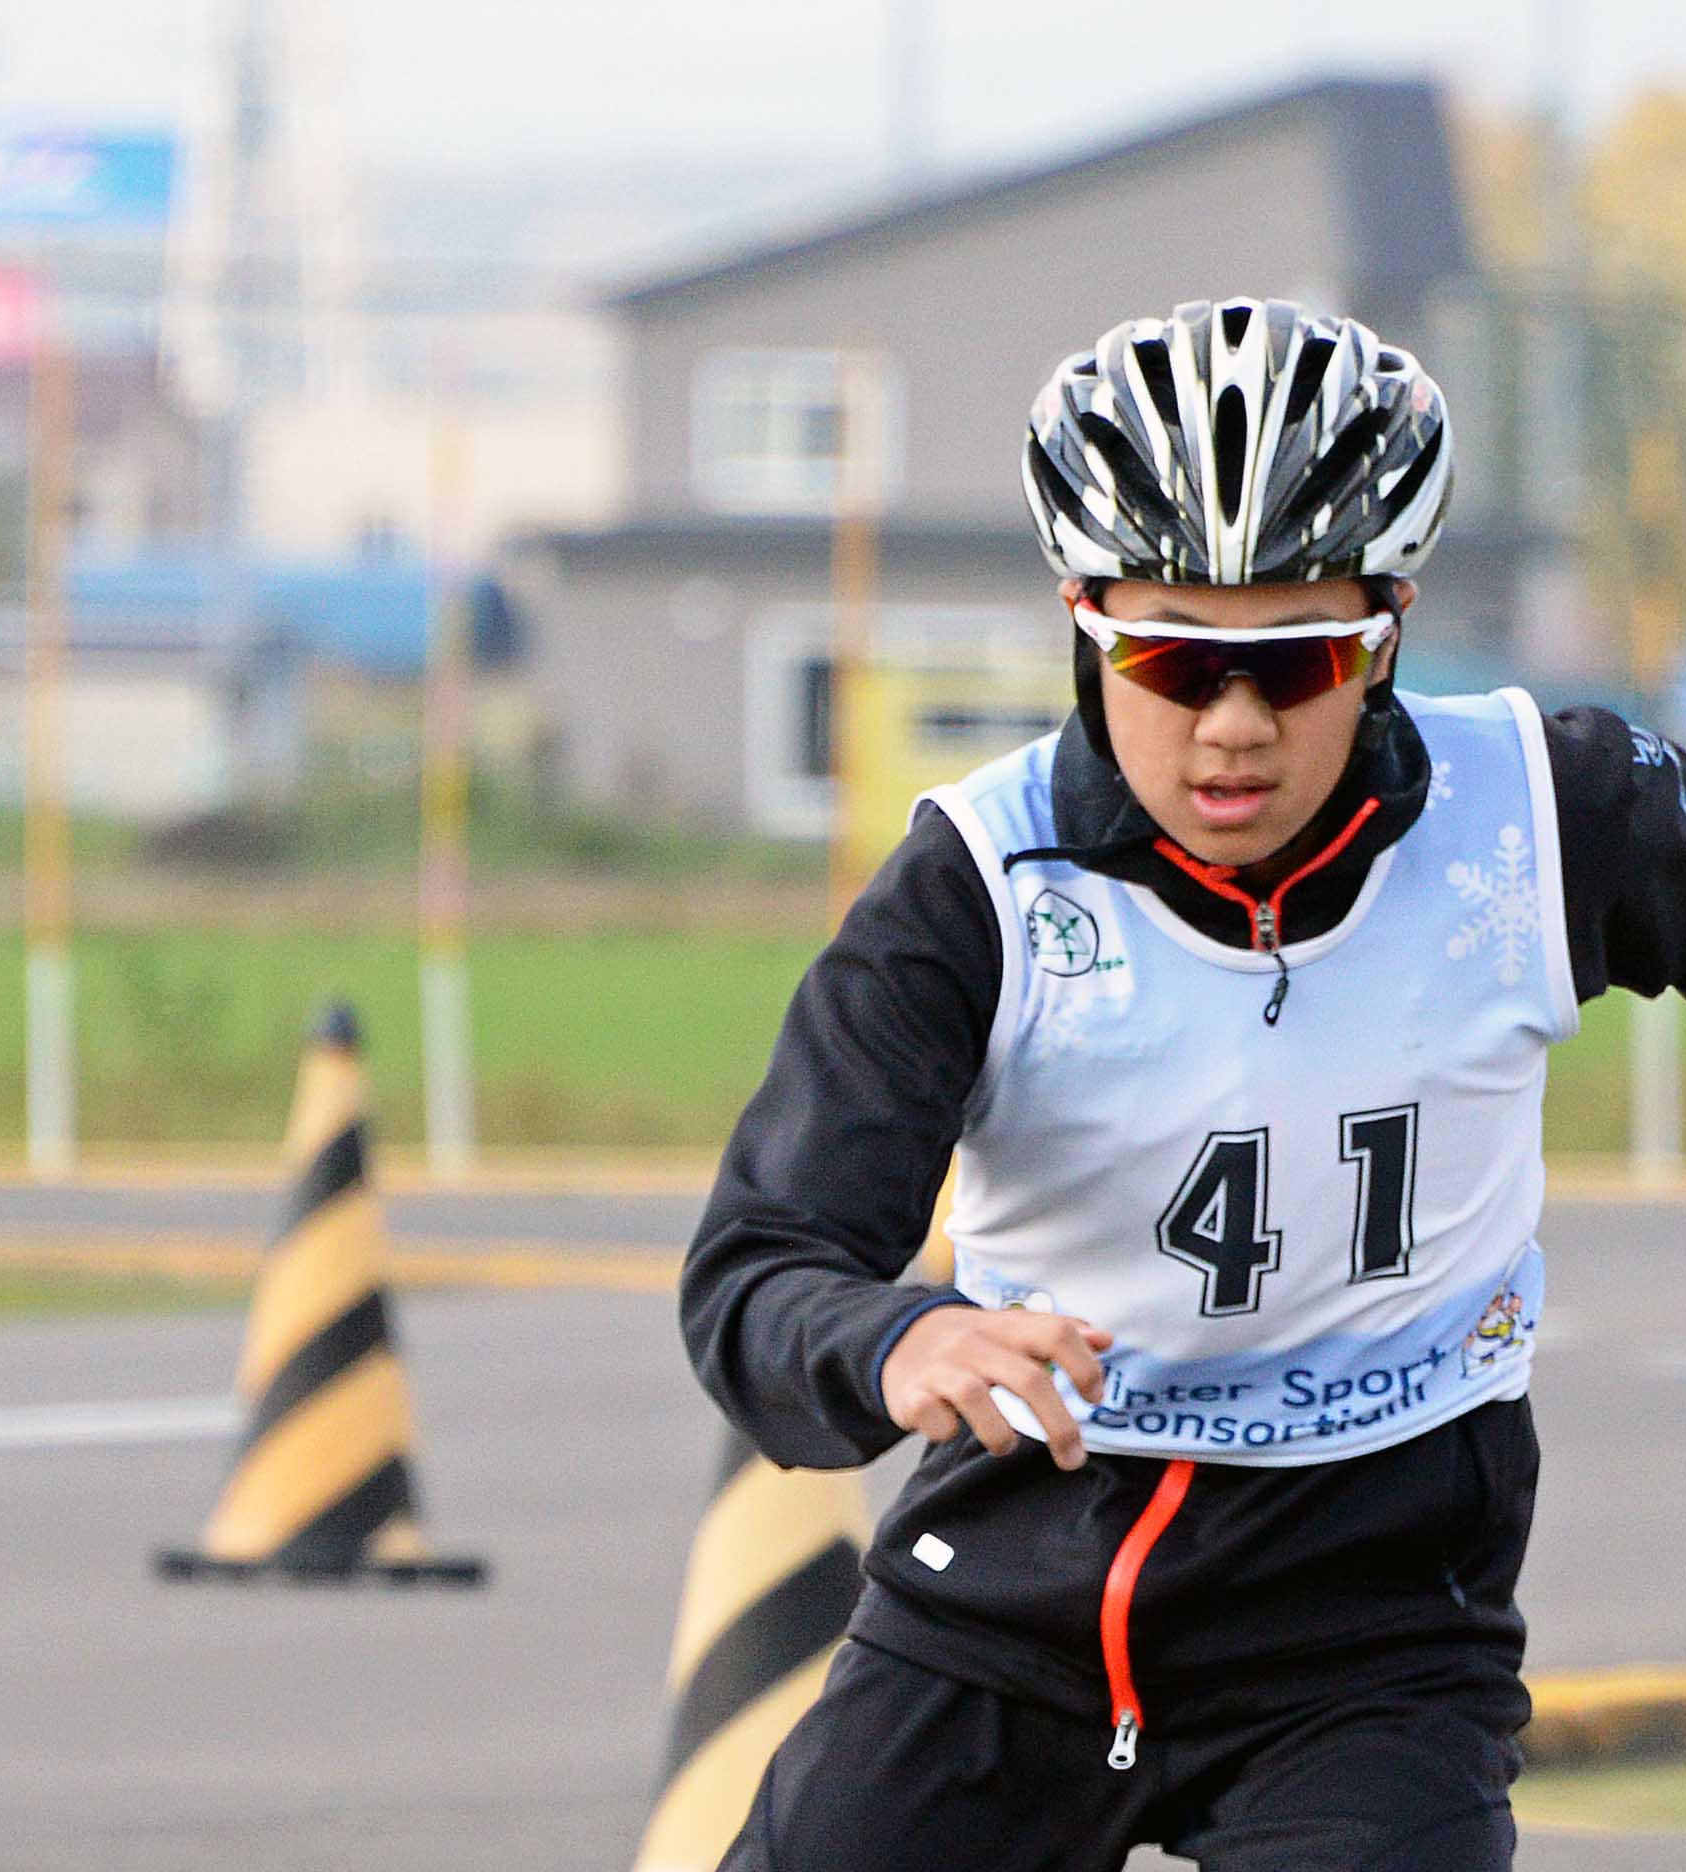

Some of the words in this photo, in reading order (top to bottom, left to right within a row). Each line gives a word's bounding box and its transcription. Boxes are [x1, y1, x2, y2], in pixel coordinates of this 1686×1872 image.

[1156, 1103, 1420, 1318] 41
[1090, 1383, 1427, 1449] Consortium
[1102, 1364, 1254, 1407] inter
